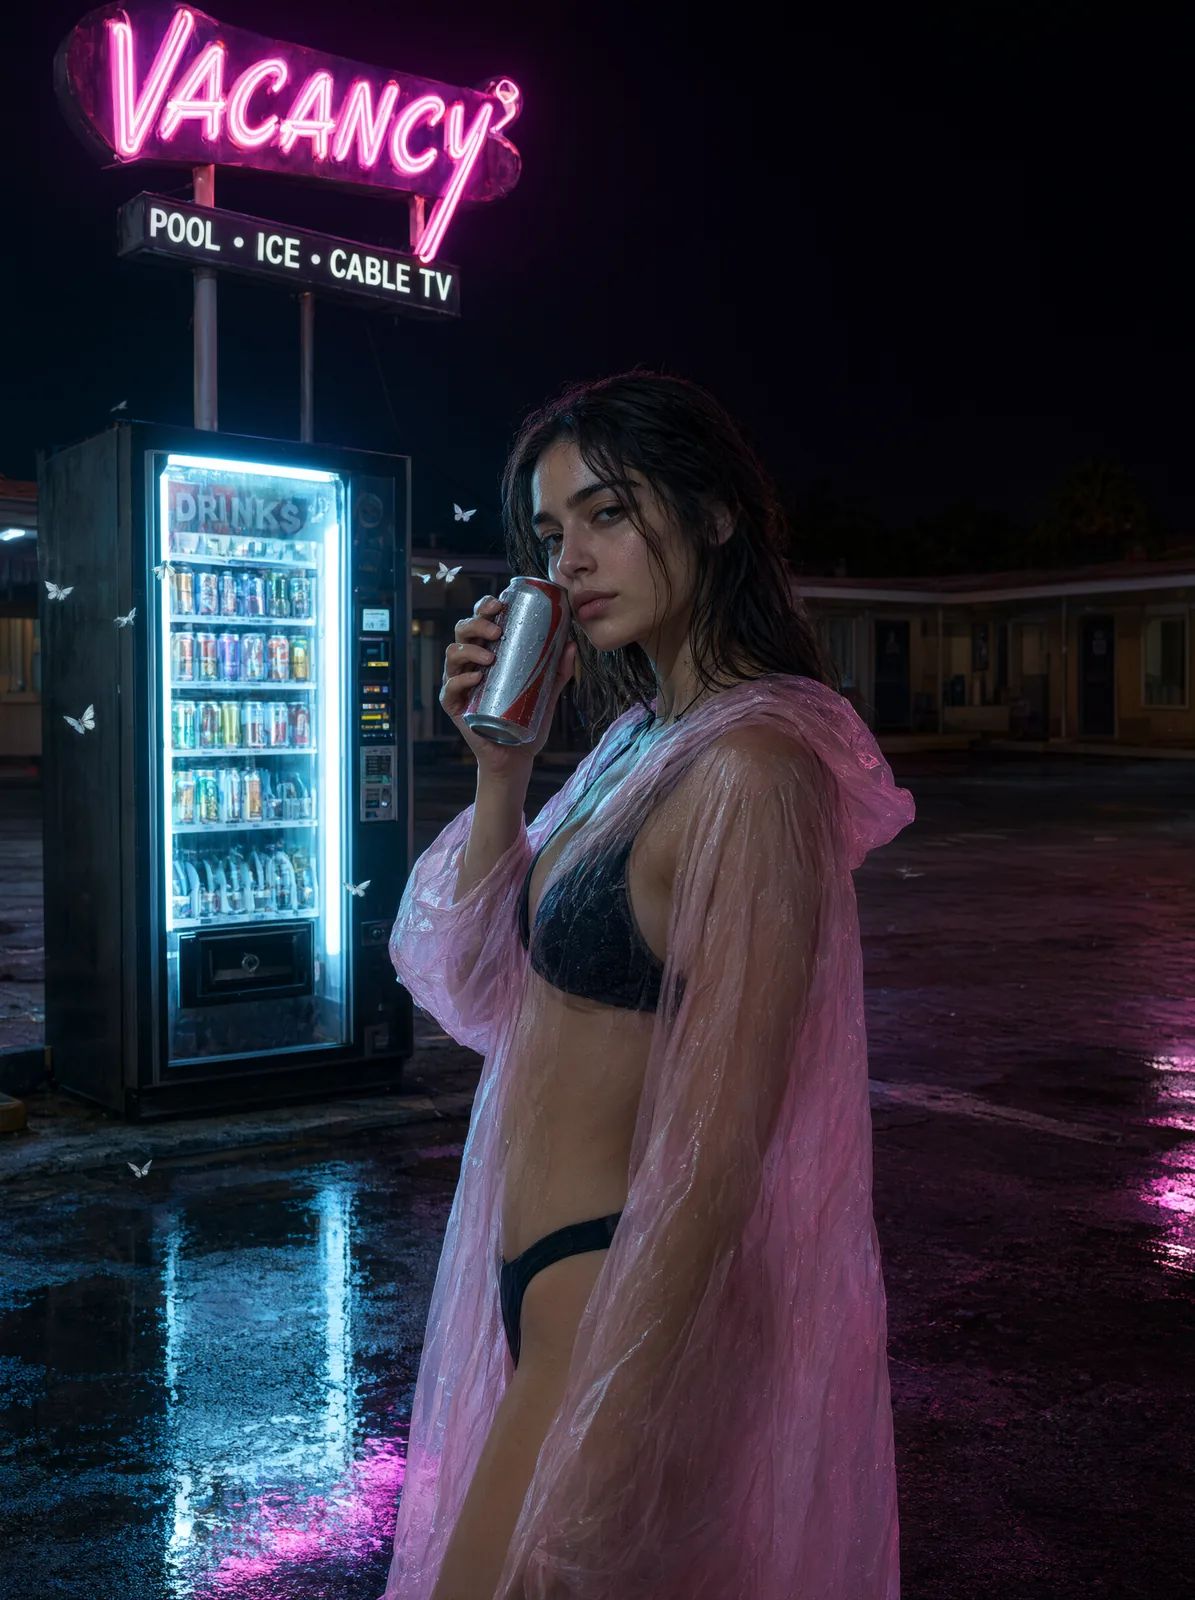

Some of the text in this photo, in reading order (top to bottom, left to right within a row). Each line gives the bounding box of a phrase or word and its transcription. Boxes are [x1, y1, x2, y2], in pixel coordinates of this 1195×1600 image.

[108, 7, 496, 263] VACANCY
[149, 207, 453, 302] POOL ICE CABLE TV
[174, 491, 302, 535] DRINKS
